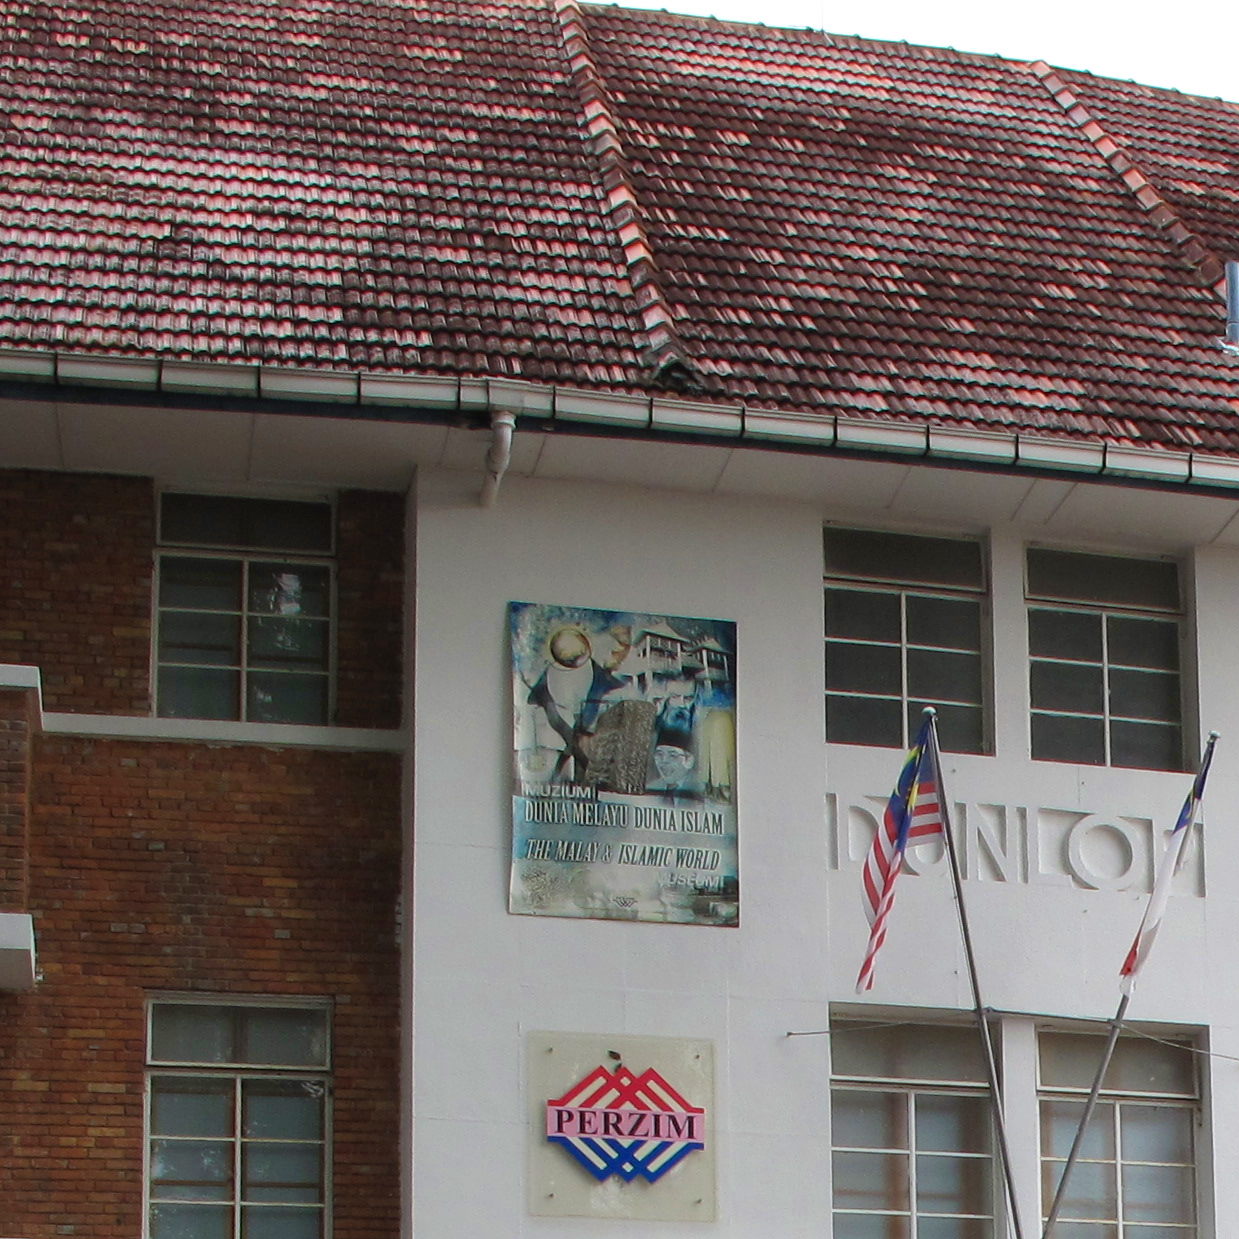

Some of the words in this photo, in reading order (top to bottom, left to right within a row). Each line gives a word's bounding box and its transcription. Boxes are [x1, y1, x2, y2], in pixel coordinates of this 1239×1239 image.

[525, 800, 572, 825] DUNIA
[573, 802, 629, 828] MELAYU
[634, 807, 676, 832] DUNIA
[680, 811, 725, 836] ISLAM
[526, 839, 552, 860] THE
[554, 840, 601, 863] MALAY
[602, 846, 612, 863] &
[618, 844, 675, 868] ISLAMIC
[675, 848, 721, 871] WORLD
[555, 1109, 696, 1140] PERZIM
